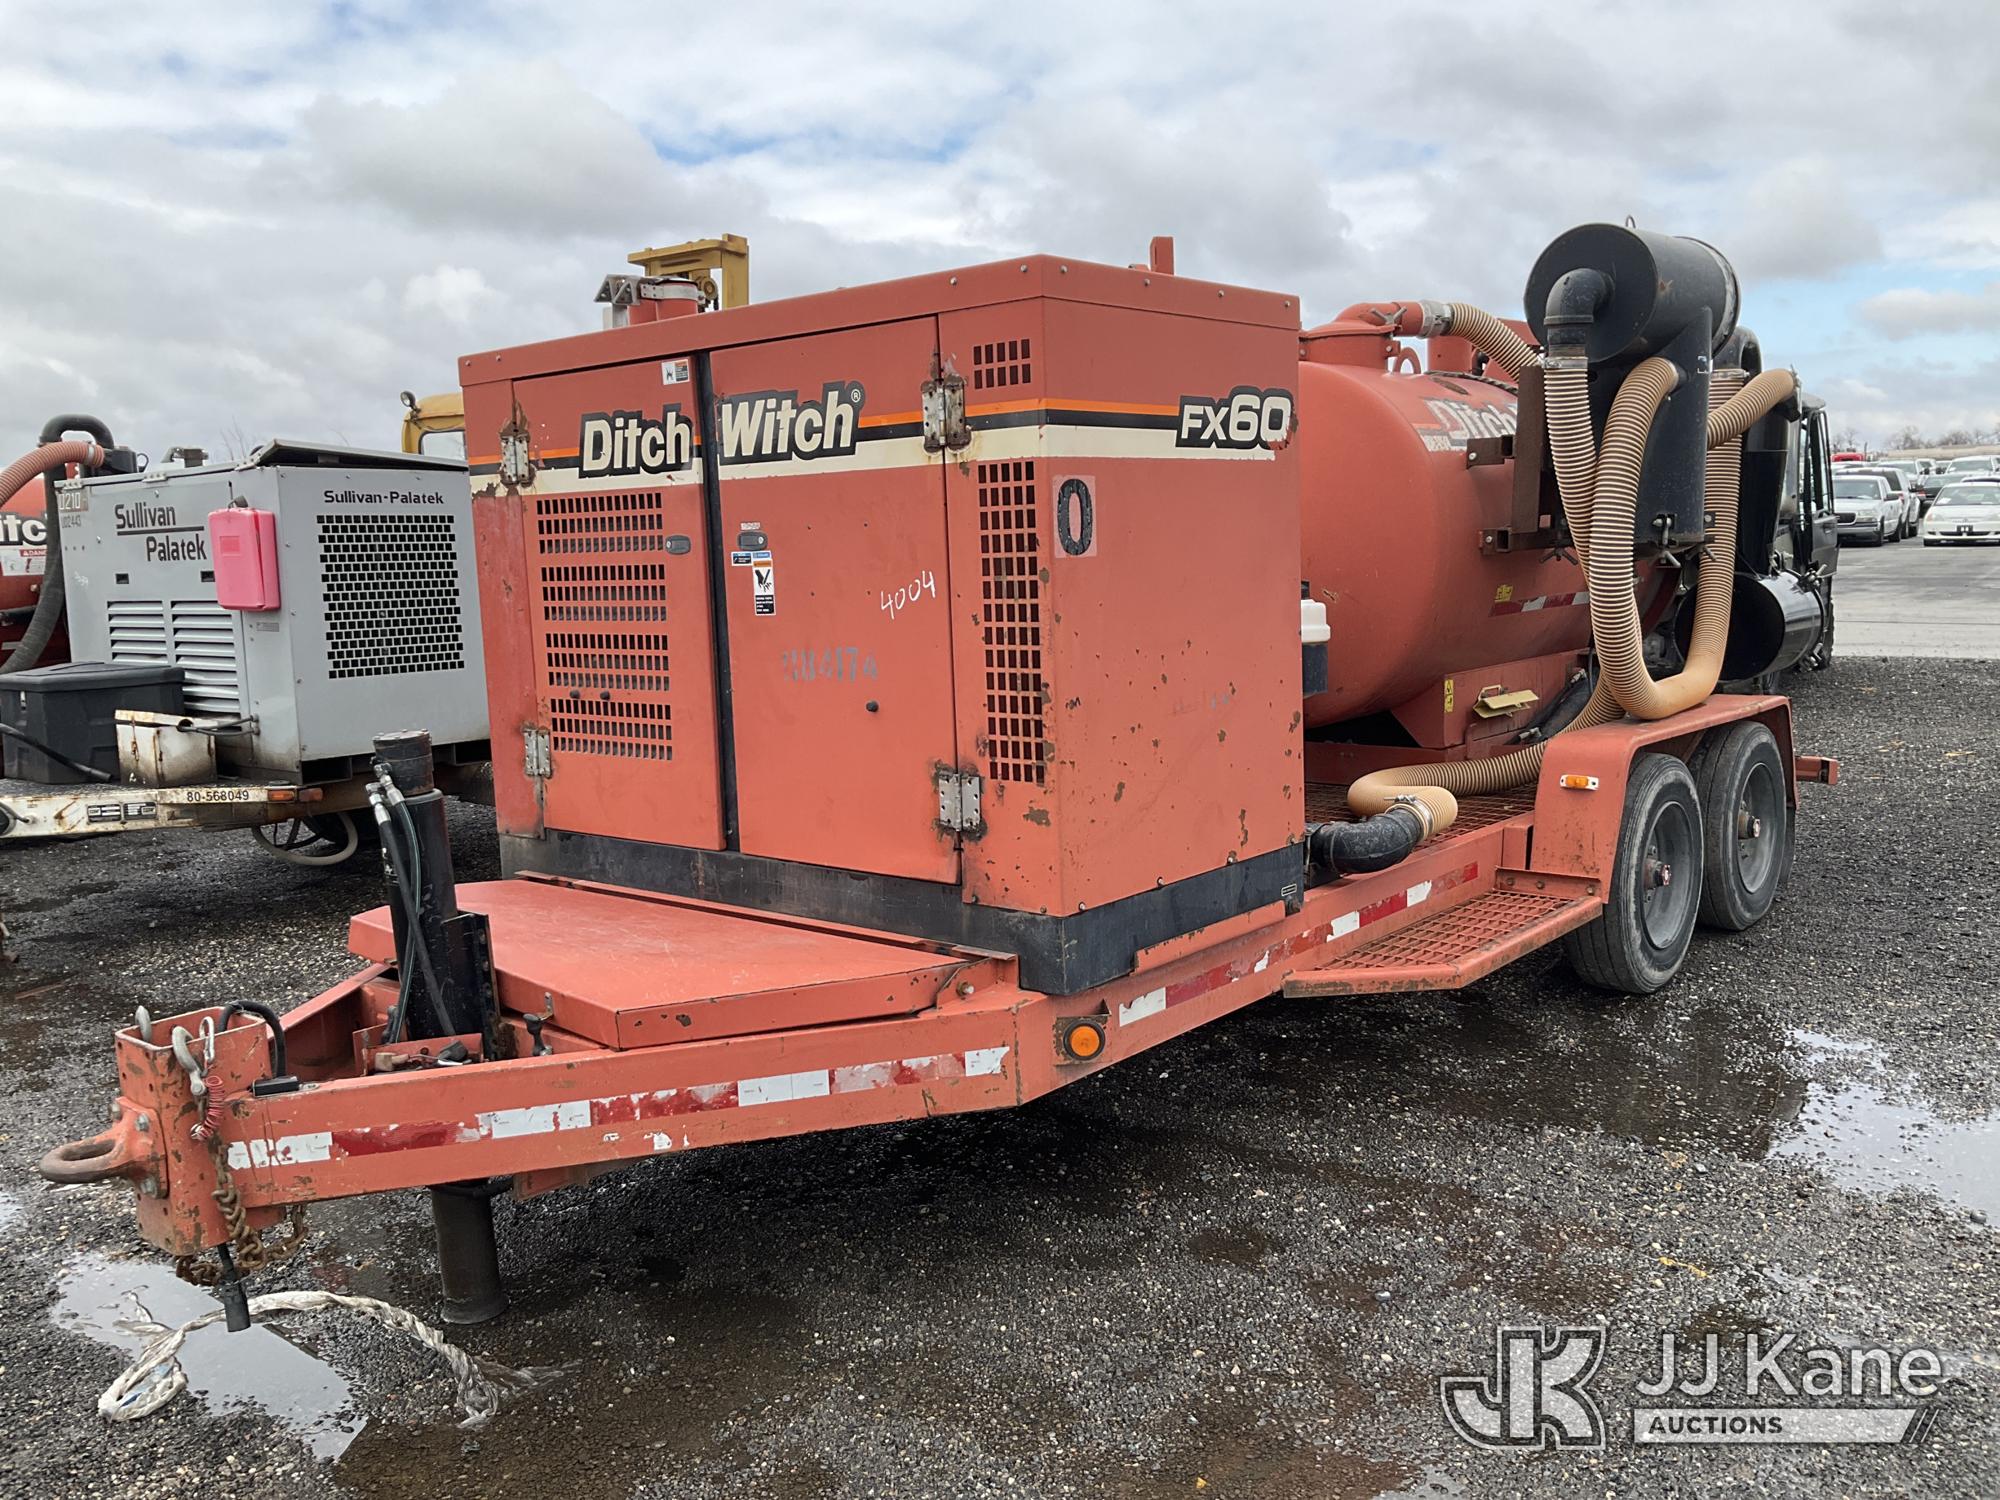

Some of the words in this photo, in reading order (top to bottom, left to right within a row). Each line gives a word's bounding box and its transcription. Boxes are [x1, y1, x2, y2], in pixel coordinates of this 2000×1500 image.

[1181, 393, 1292, 442] FX60
[583, 411, 690, 471] Ditch
[115, 501, 176, 529] Sullivan
[323, 490, 444, 504] Sullivan-Palatek
[1057, 479, 1092, 555] 0
[146, 533, 207, 562] Palatek
[880, 570, 936, 620] 4004
[186, 790, 250, 803] 80-568049
